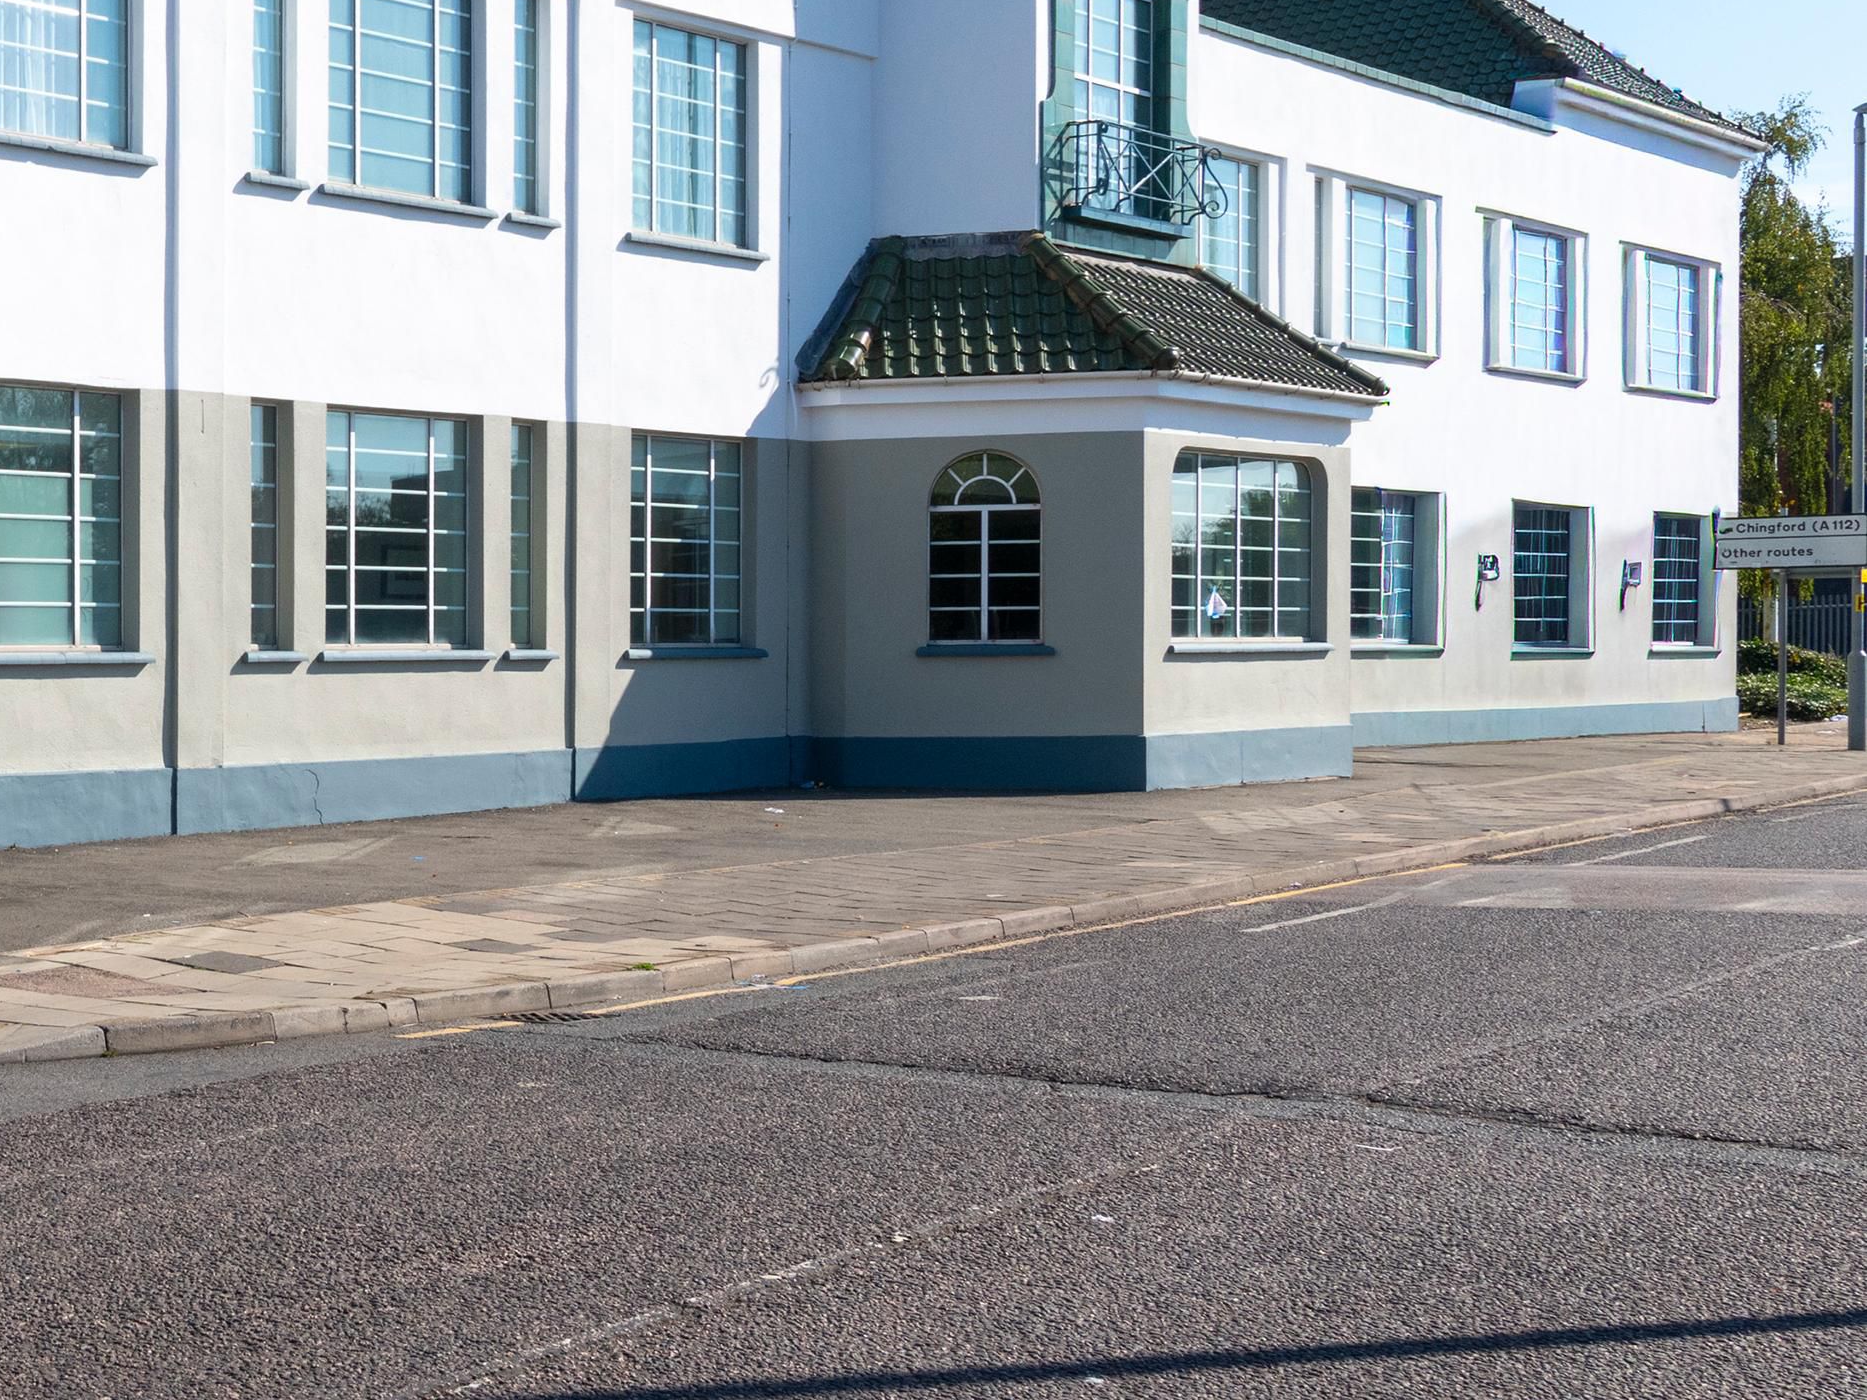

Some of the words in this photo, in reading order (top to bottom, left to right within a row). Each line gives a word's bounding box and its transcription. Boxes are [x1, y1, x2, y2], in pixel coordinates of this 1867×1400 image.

[1736, 521, 1806, 534] Chingford
[1721, 547, 1763, 559] Other
[1767, 546, 1814, 557] routes
